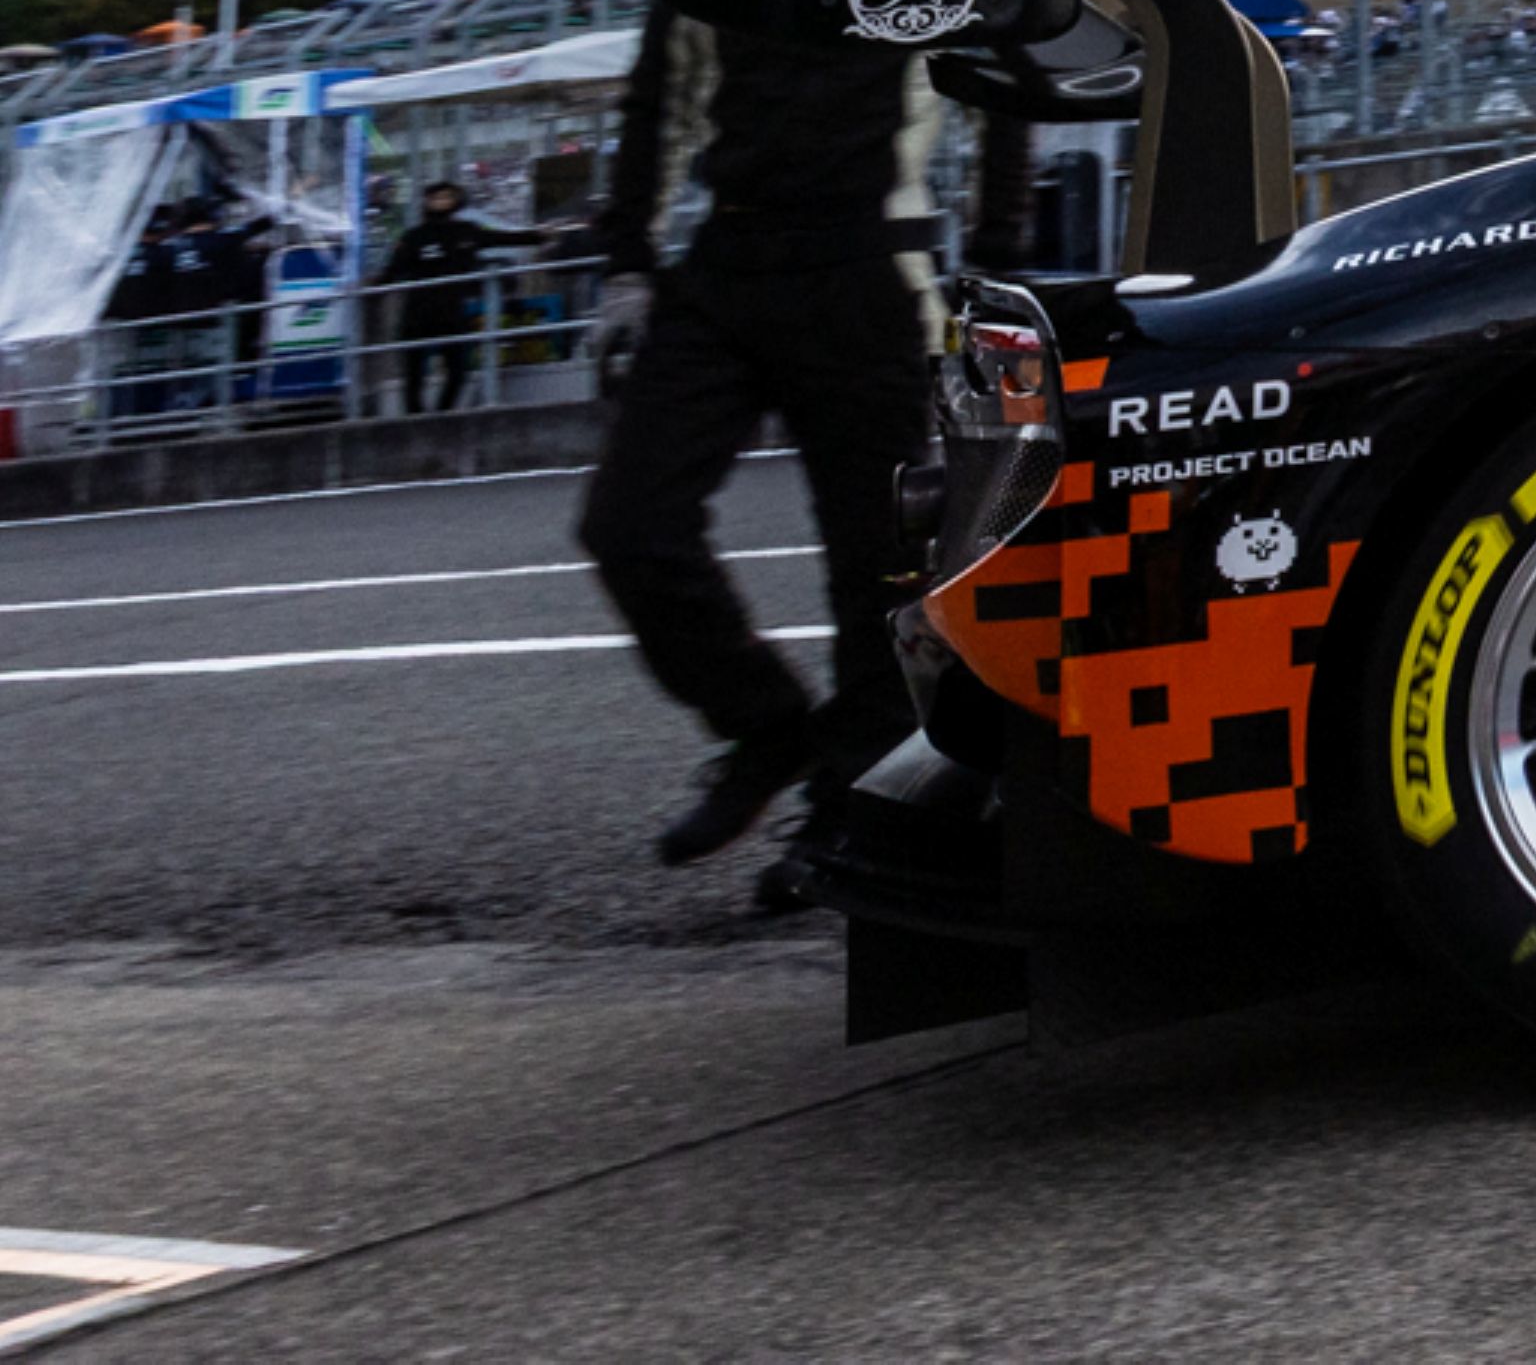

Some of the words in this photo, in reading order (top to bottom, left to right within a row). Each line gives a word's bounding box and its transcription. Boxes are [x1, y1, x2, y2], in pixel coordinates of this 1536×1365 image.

[1109, 379, 1292, 437] READ
[1110, 450, 1256, 488] PROJECT
[1263, 436, 1371, 469] OCEAN
[1405, 533, 1482, 790] DUNLOP
